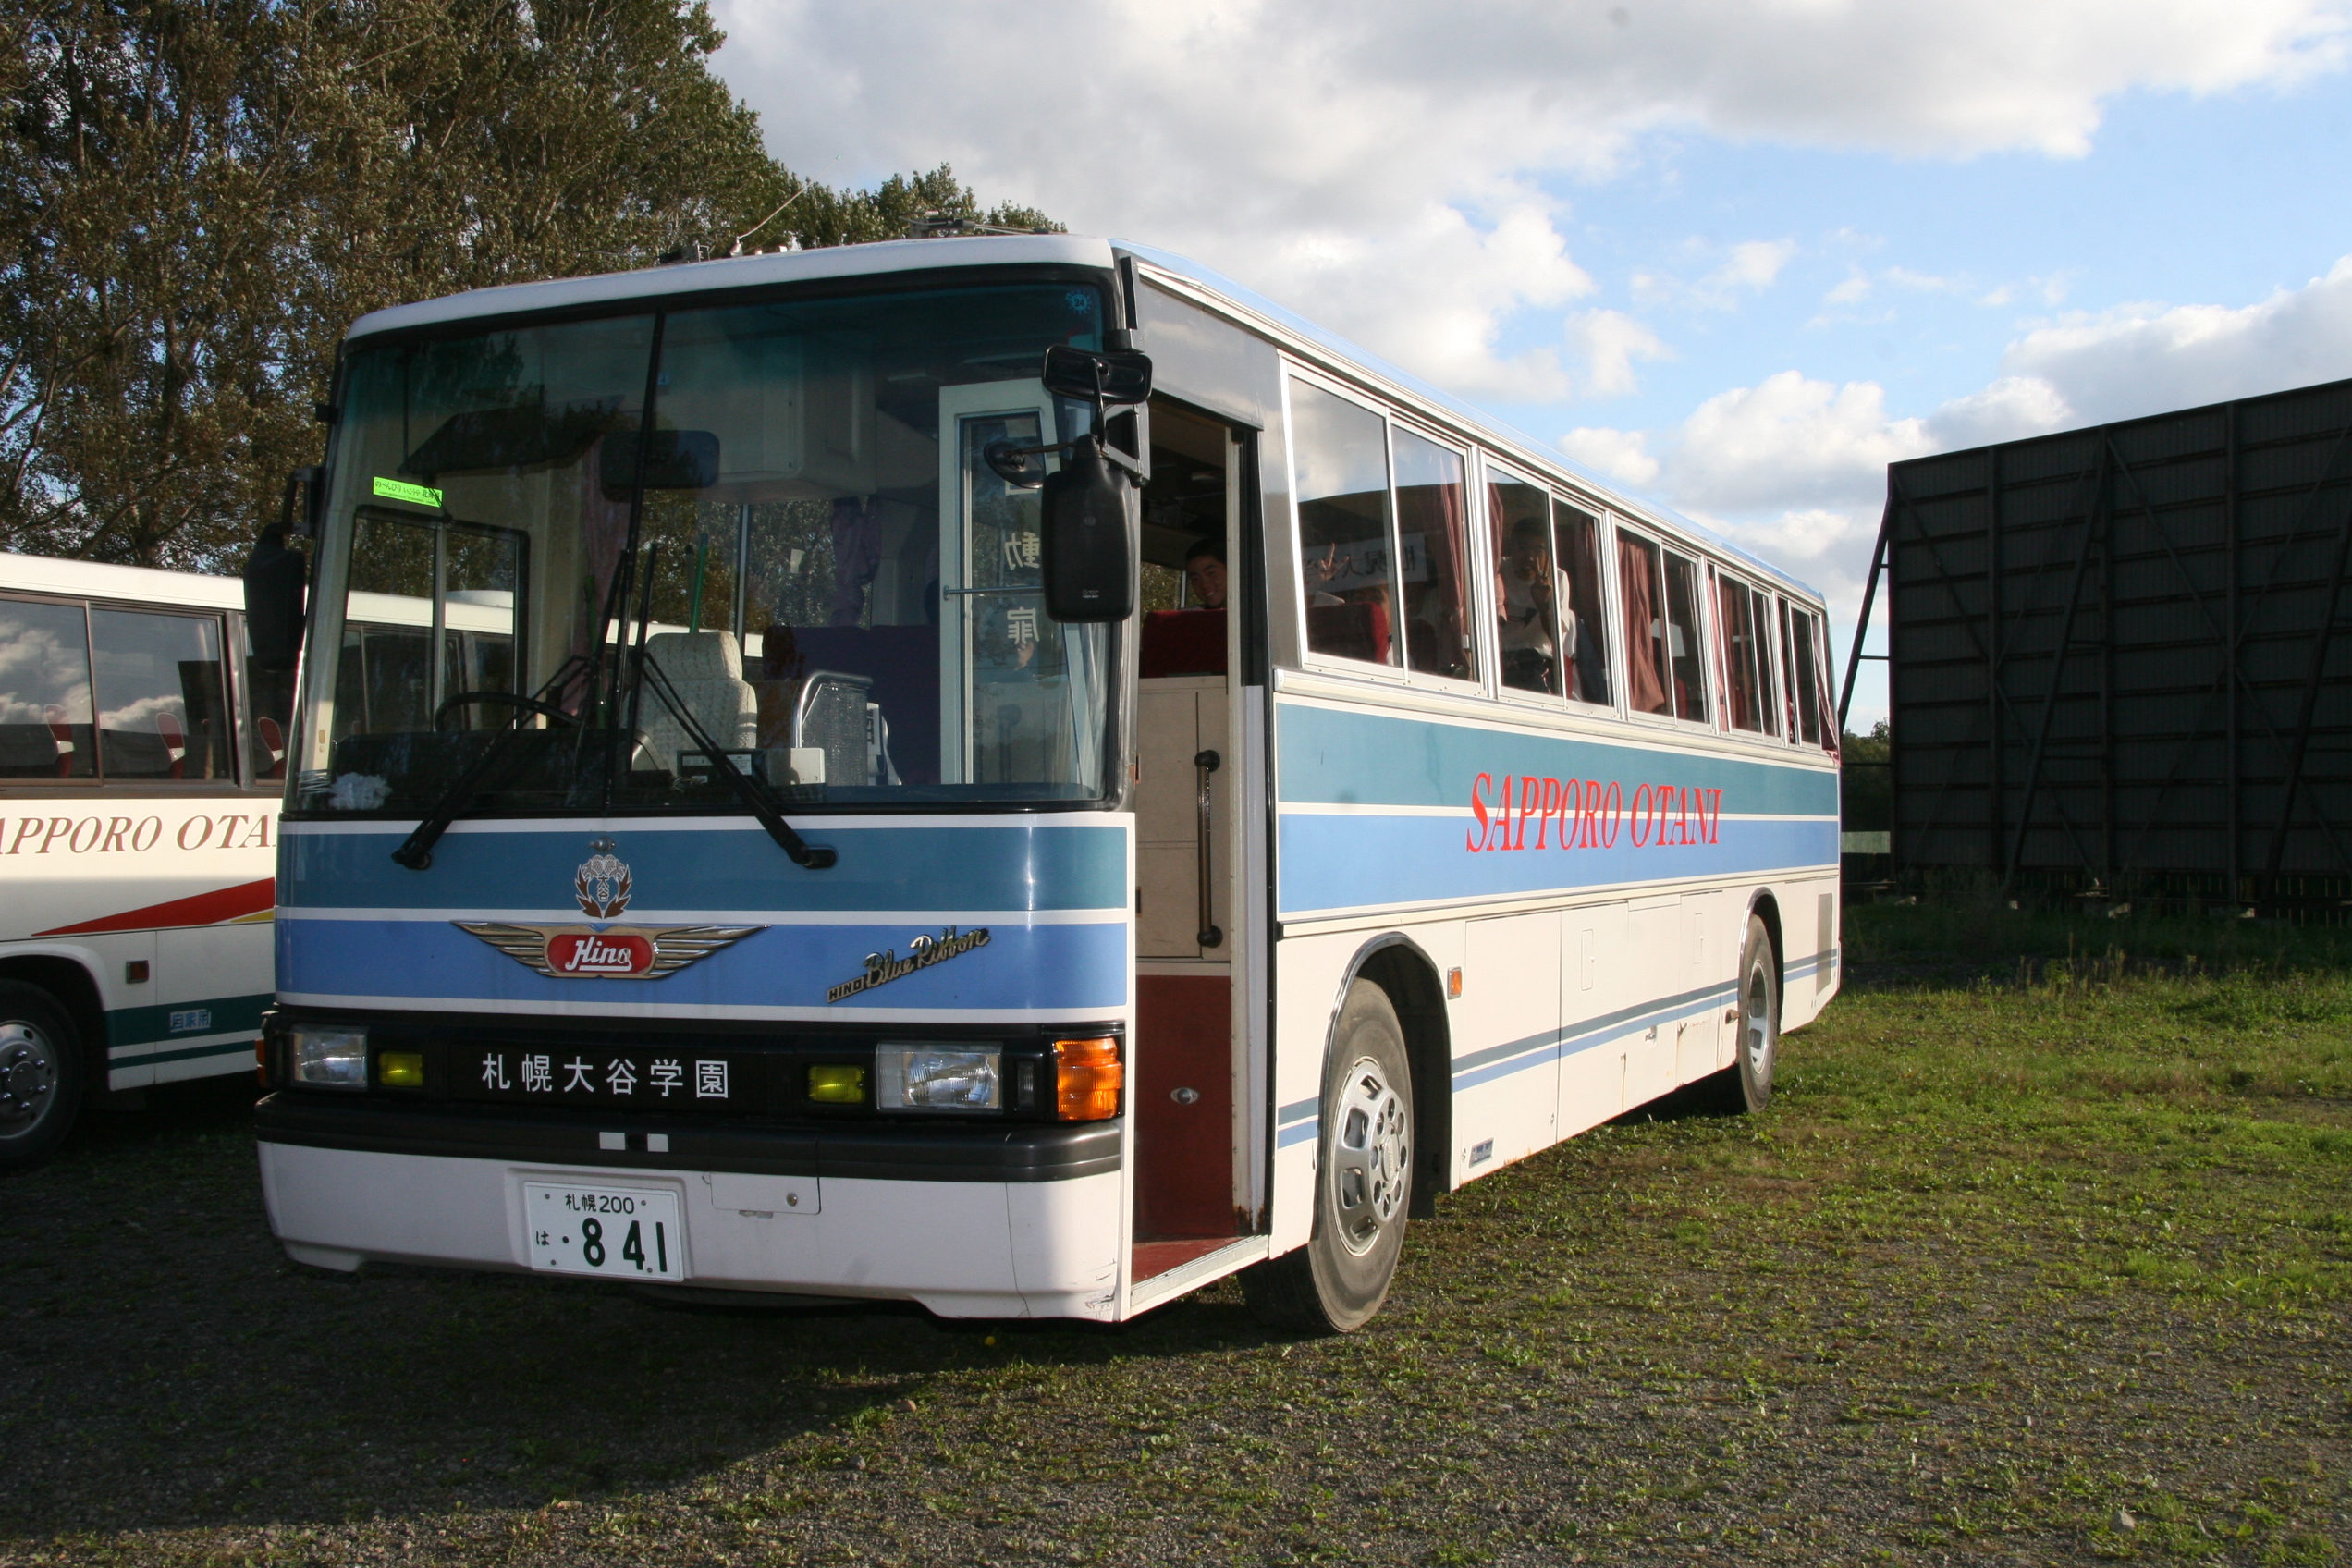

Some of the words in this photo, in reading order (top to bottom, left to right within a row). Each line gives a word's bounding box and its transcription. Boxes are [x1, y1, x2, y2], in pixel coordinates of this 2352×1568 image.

[1466, 772, 1623, 852] SAPPORO
[1630, 783, 1723, 848] OTANI
[176, 815, 276, 851] OTA
[596, 874, 610, 902] 大谷
[565, 936, 633, 972] Hino
[828, 977, 864, 1002] HINO
[864, 949, 915, 988] Blue
[910, 925, 992, 969] Ribbon
[482, 1052, 729, 1099] 札幌大谷学園
